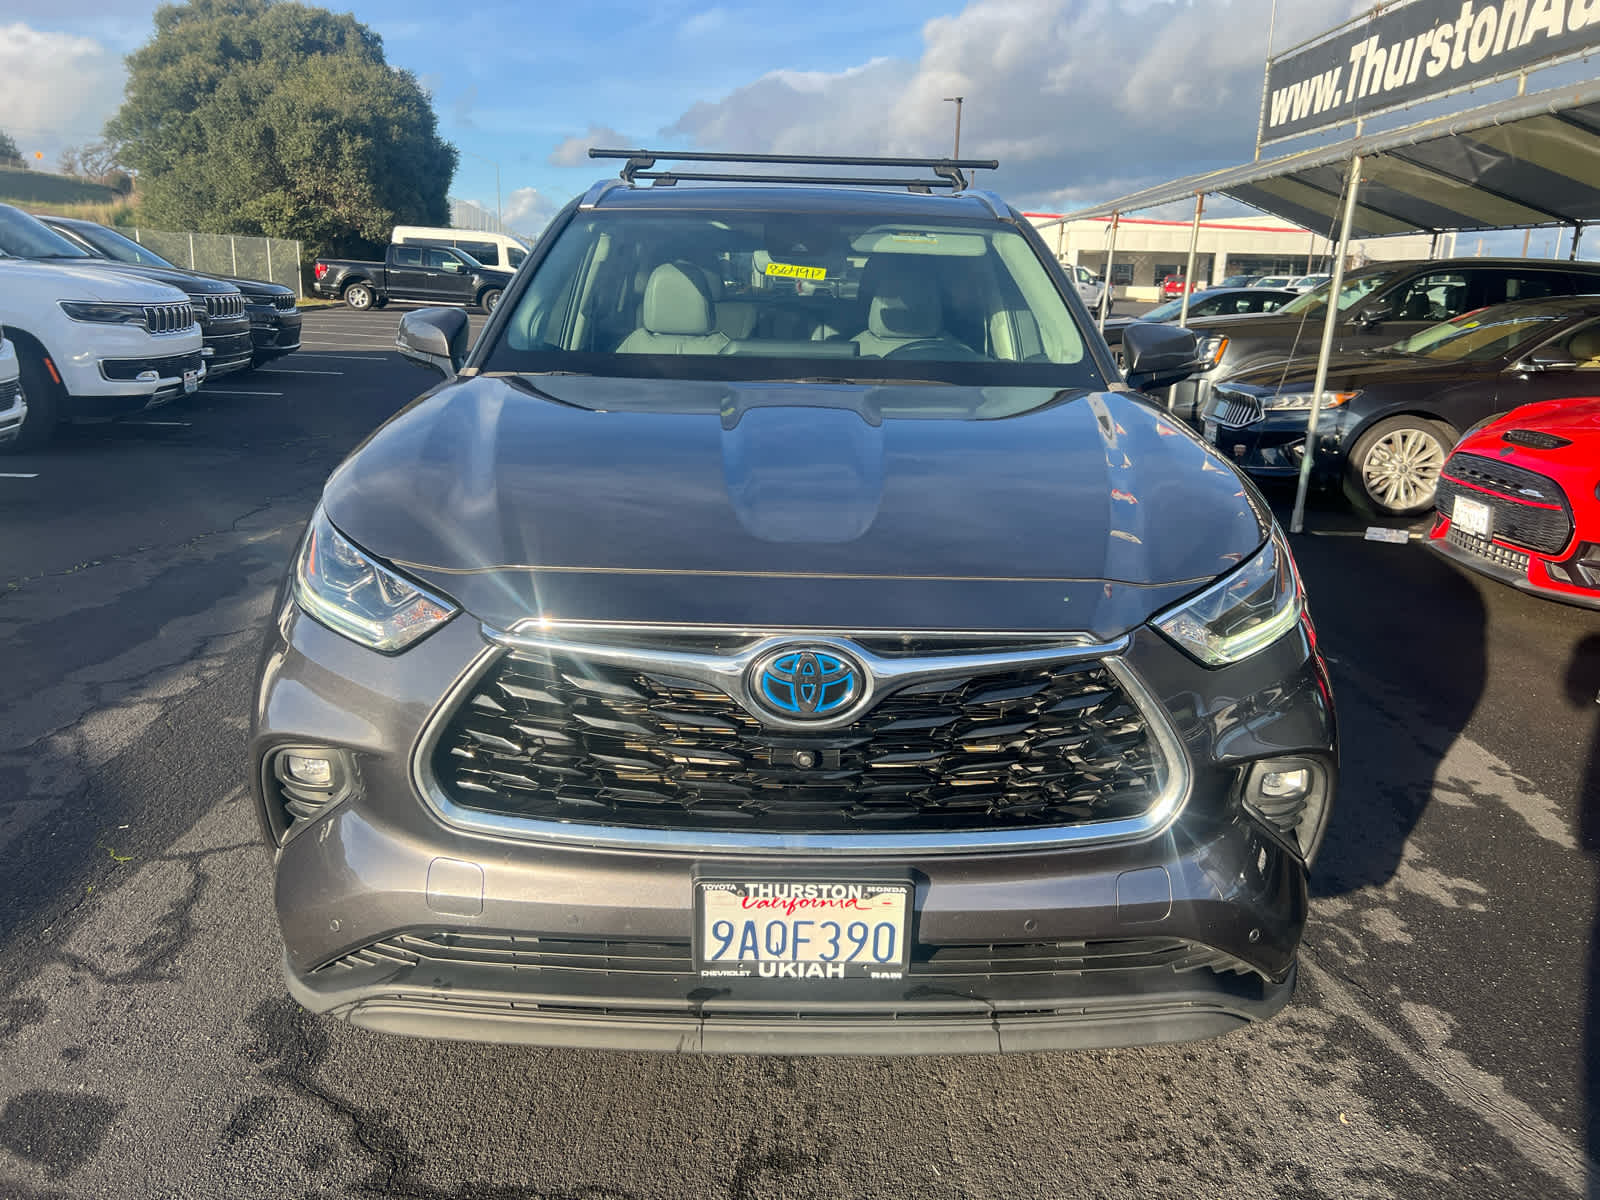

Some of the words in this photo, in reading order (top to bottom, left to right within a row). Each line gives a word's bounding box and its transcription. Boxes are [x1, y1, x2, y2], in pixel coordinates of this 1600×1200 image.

[745, 884, 862, 899] THURSTON
[867, 886, 907, 894] HONDA
[742, 896, 873, 916] California
[711, 920, 896, 963] 9AQF390
[758, 962, 845, 979] UKIAH
